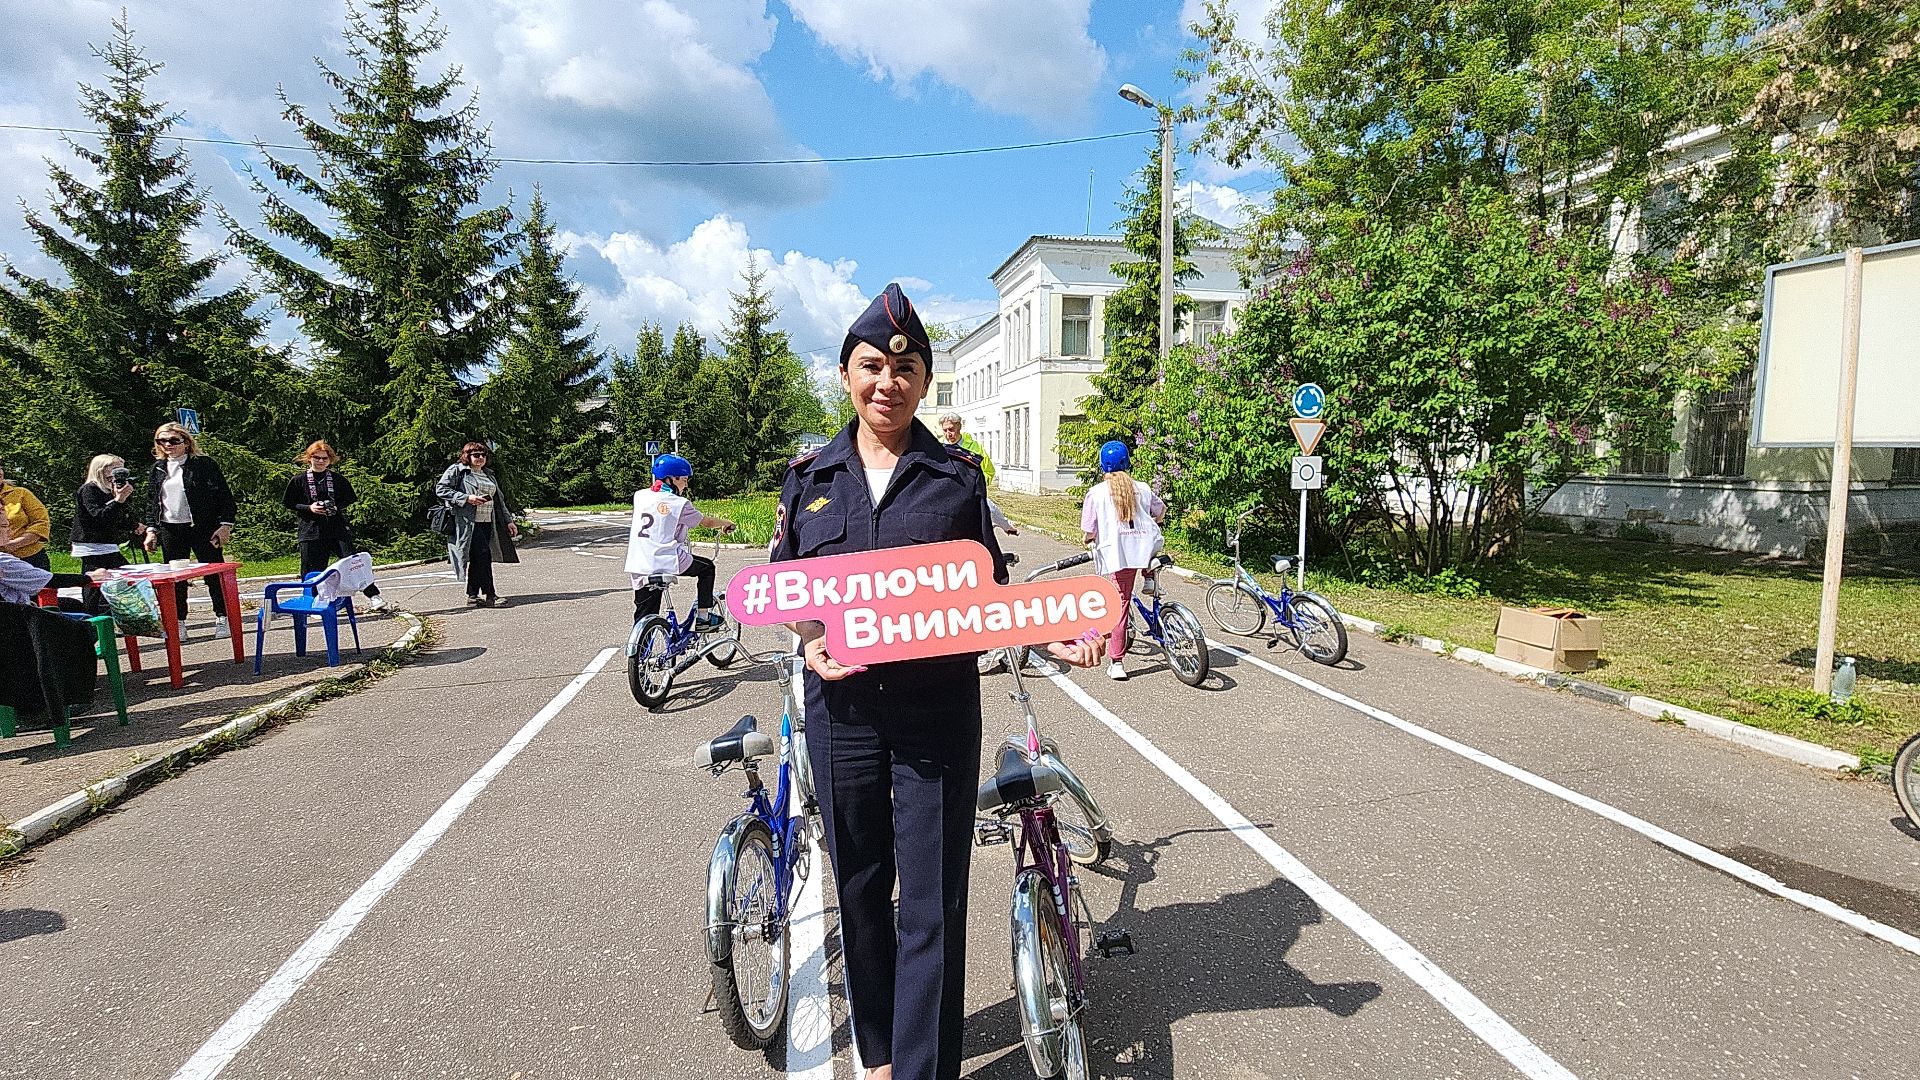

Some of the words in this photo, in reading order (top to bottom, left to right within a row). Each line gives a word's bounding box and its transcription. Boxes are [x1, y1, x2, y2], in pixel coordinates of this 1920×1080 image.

[637, 512, 655, 538] 2
[742, 560, 978, 616] #Включи
[843, 591, 1108, 649] Внимание
